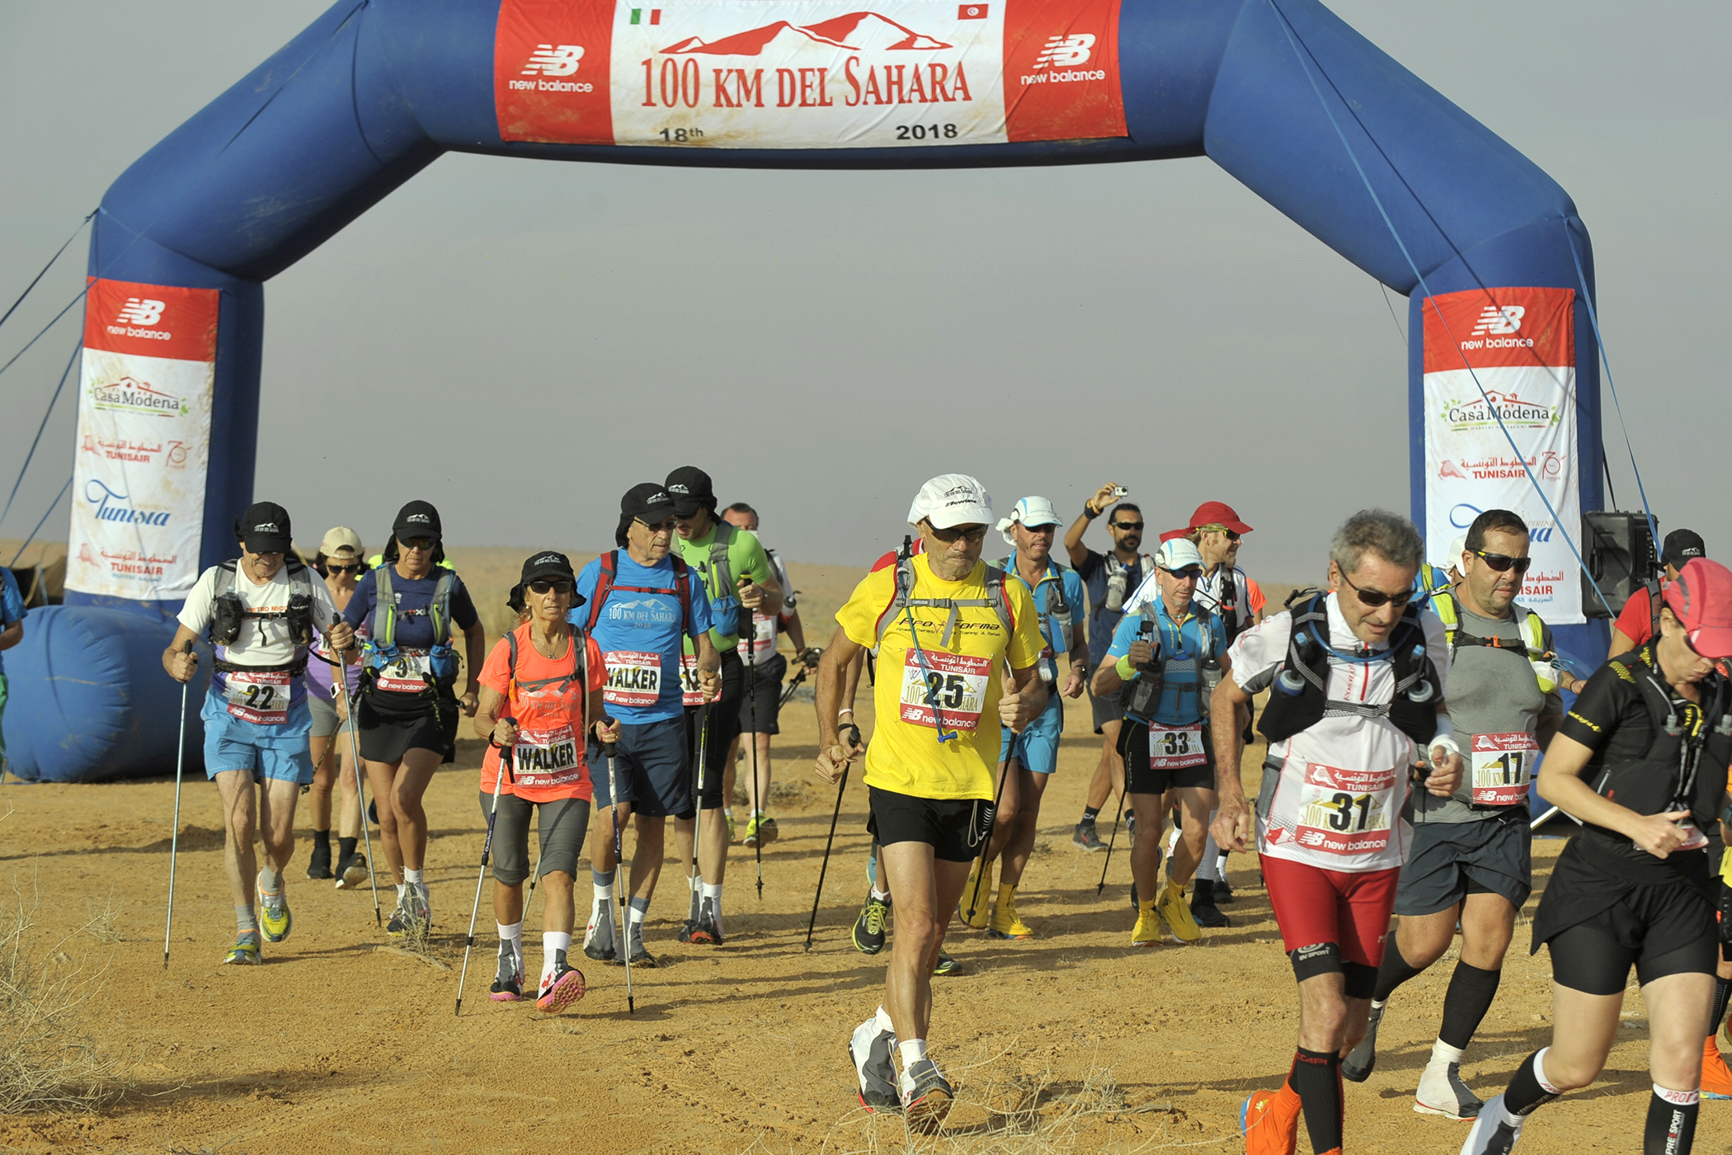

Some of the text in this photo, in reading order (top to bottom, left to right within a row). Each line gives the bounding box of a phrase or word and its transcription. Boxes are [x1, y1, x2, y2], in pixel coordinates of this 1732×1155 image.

[641, 55, 972, 108] 100 KM DEL SAHARA
[1021, 69, 1105, 85] new balance
[509, 79, 593, 93] new balance
[659, 127, 704, 142] 18th
[895, 123, 958, 140] 2018
[107, 325, 171, 341] new balance
[1461, 337, 1534, 350] new balance
[122, 391, 179, 410] Modena
[1449, 404, 1550, 423] Casa Modena
[105, 450, 150, 463] TUNISAIR
[1472, 469, 1526, 479] TUNISAIR
[85, 479, 171, 527] Tunisia
[111, 562, 163, 575] TUNISAIR
[1518, 585, 1553, 595] ISAIR
[608, 607, 677, 622] 100 KM DEL SAHARA
[940, 664, 976, 674] TUNISAIR
[246, 685, 274, 710] 22
[923, 671, 964, 709] 25
[615, 694, 656, 705] new balance
[942, 716, 976, 728] balance
[1164, 732, 1189, 755] 33
[517, 742, 575, 771] WALKER
[1179, 757, 1205, 766] balance
[1498, 751, 1523, 784] 17
[551, 773, 579, 784] balance
[1346, 783, 1385, 791] TUNISAIR
[1496, 794, 1513, 802] new
[1329, 792, 1372, 831] 31
[1323, 839, 1387, 851] new balance
